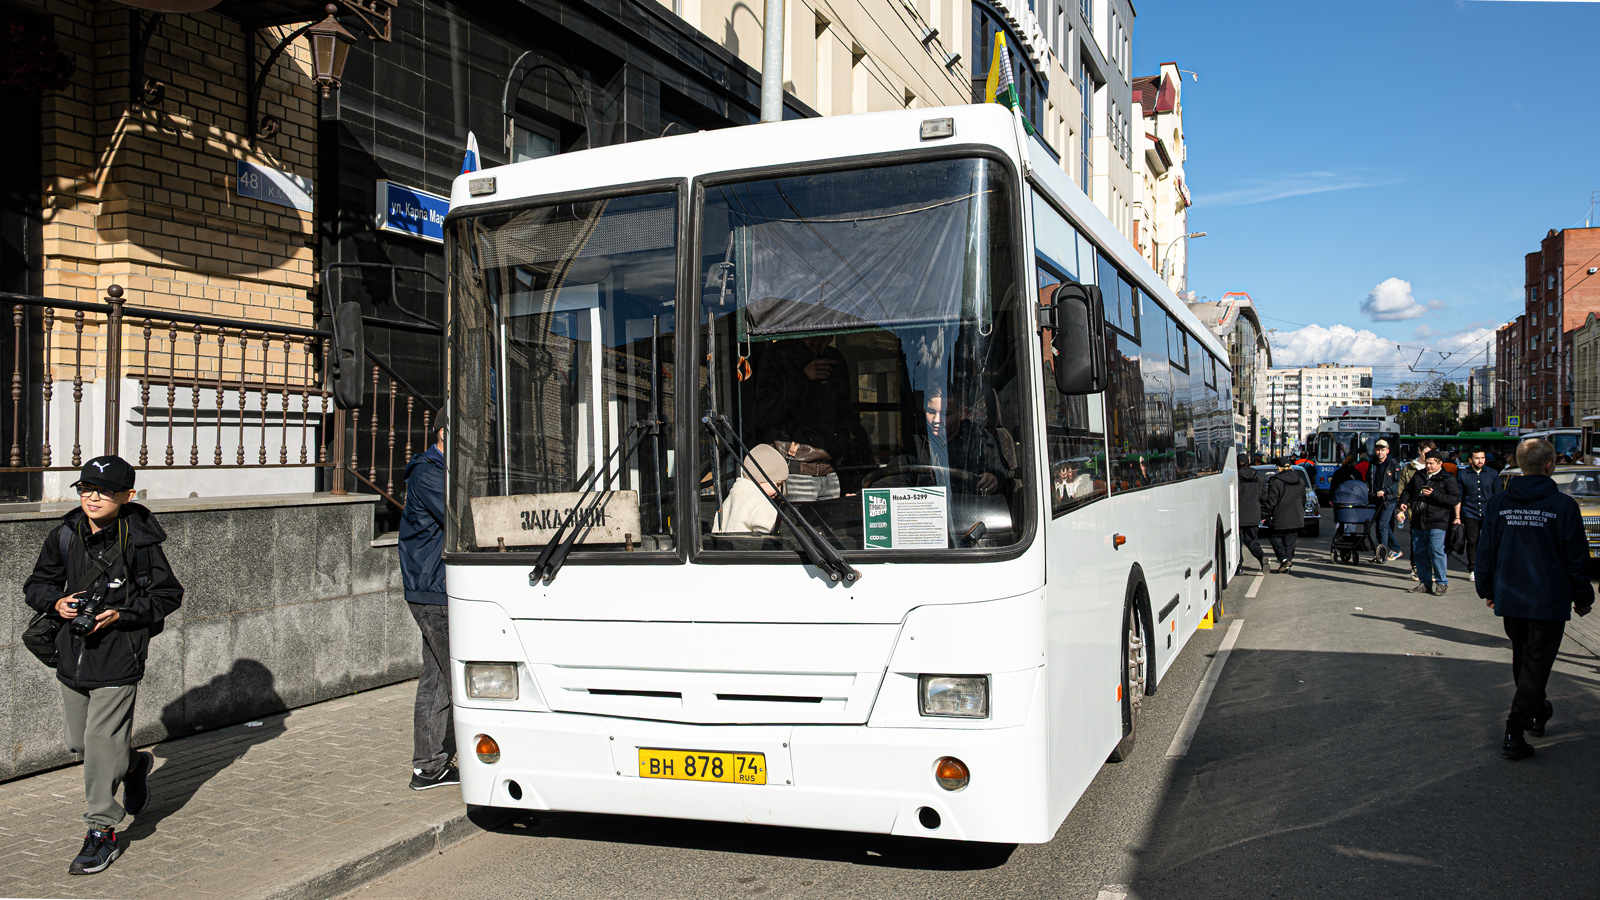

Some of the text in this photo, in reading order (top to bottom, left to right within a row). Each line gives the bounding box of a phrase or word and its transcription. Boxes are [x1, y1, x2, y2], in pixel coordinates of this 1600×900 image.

[240, 171, 259, 189] 48
[391, 201, 404, 216] ул.
[405, 202, 428, 221] Карла
[684, 755, 724, 779] 878
[736, 757, 758, 775] 74
[739, 774, 755, 782] RUS
